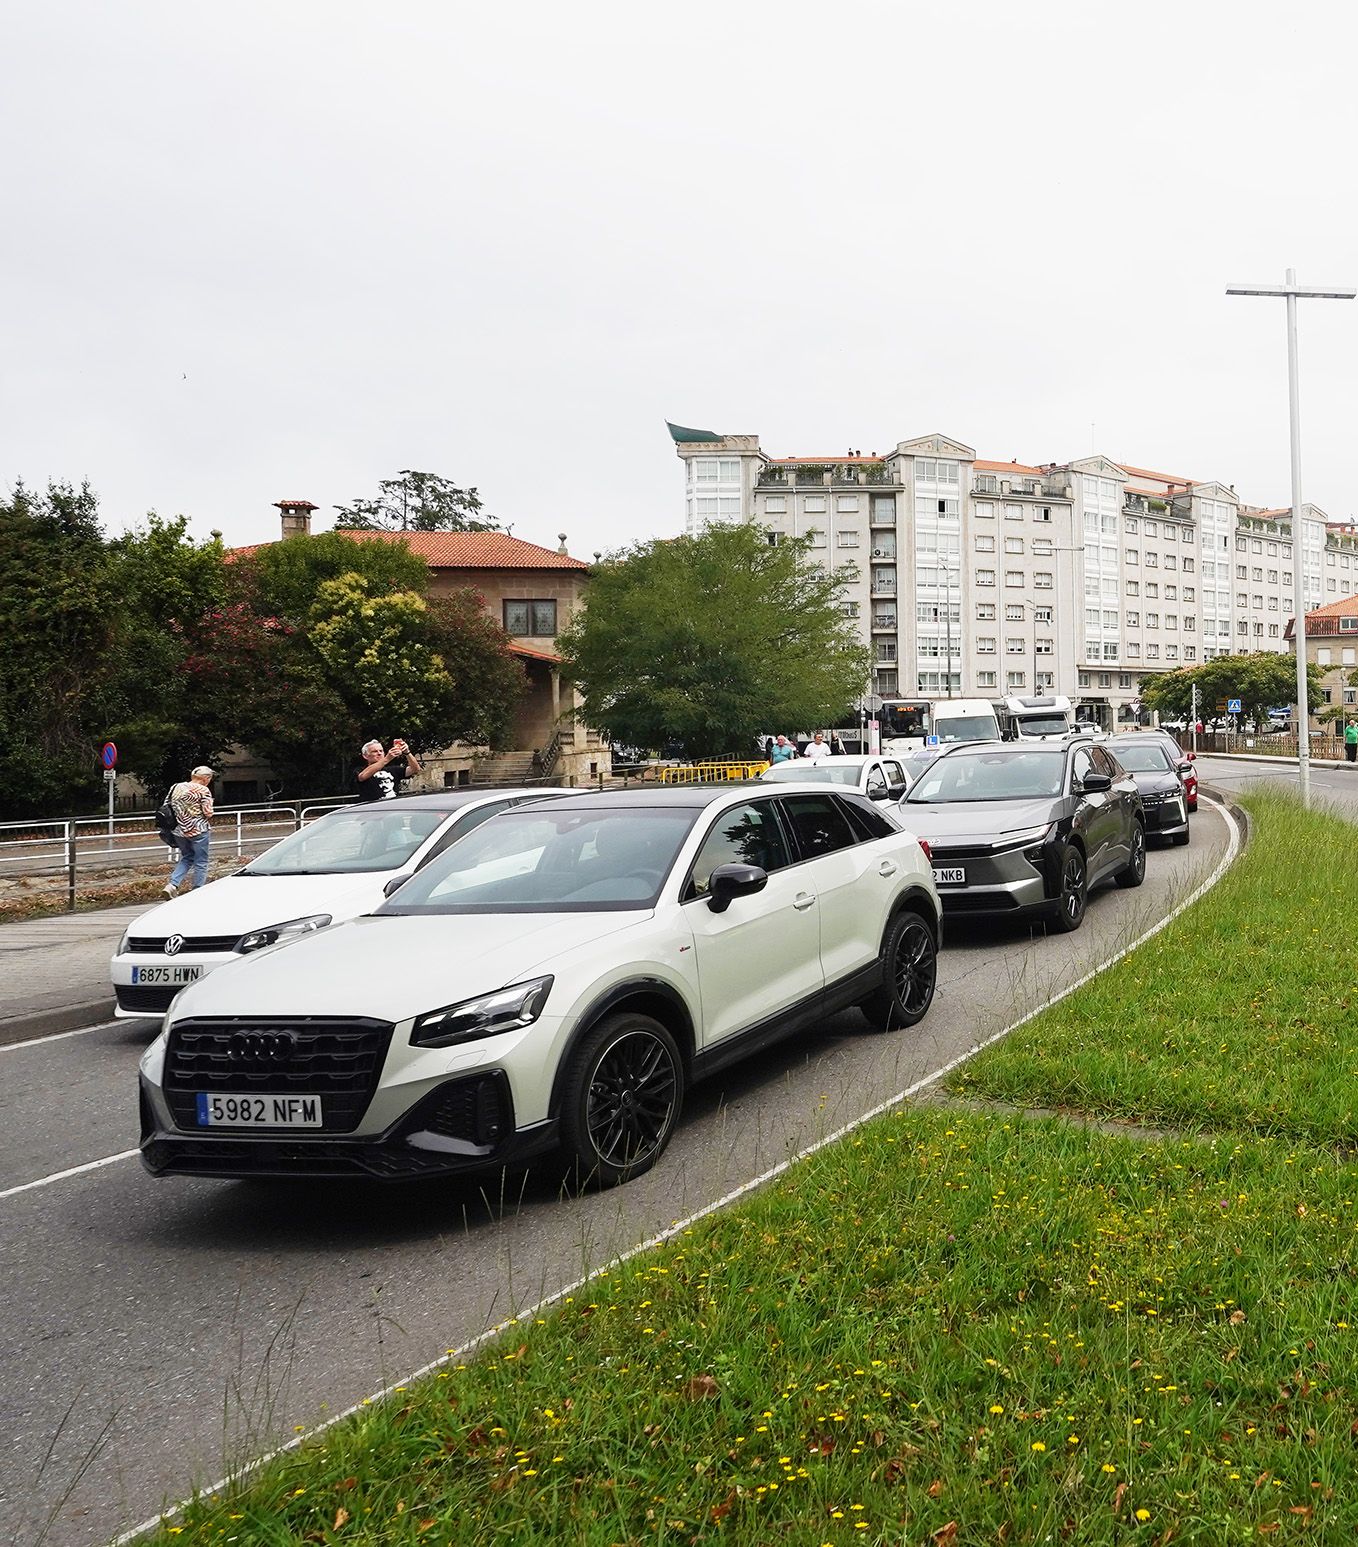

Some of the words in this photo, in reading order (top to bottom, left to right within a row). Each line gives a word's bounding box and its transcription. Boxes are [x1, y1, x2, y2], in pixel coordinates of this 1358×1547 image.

[941, 870, 963, 882] NKB
[140, 968, 170, 982] 6875
[174, 968, 199, 982] HWN
[213, 1098, 266, 1122] 5982
[273, 1099, 316, 1122] NFM
